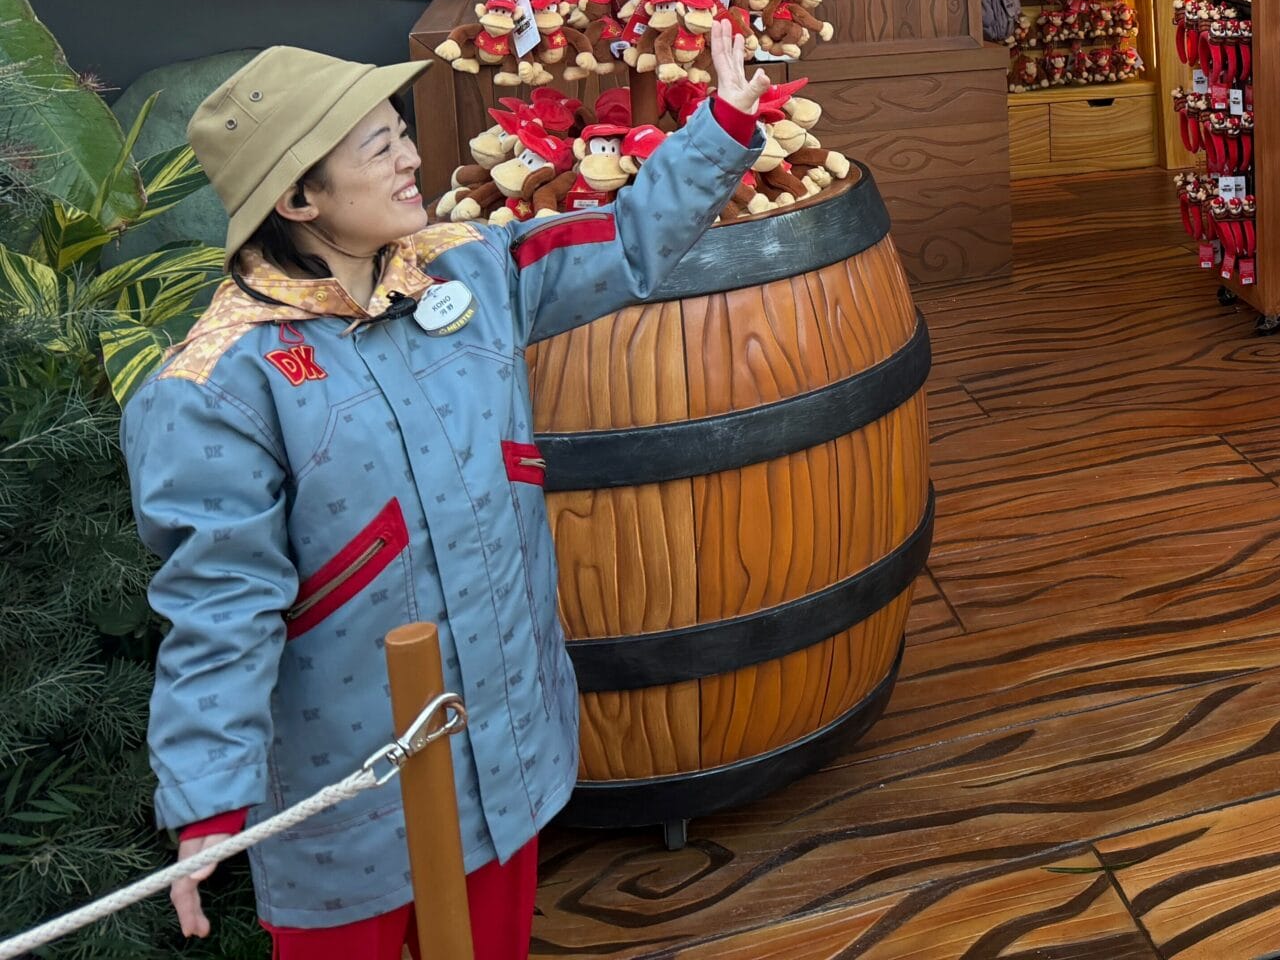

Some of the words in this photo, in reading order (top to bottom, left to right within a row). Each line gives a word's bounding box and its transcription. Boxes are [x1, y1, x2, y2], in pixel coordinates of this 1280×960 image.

[431, 295, 452, 312] KONO
[264, 345, 328, 386] DK
[204, 444, 224, 460] DK
[203, 497, 224, 512] DK
[327, 498, 348, 515] DK
